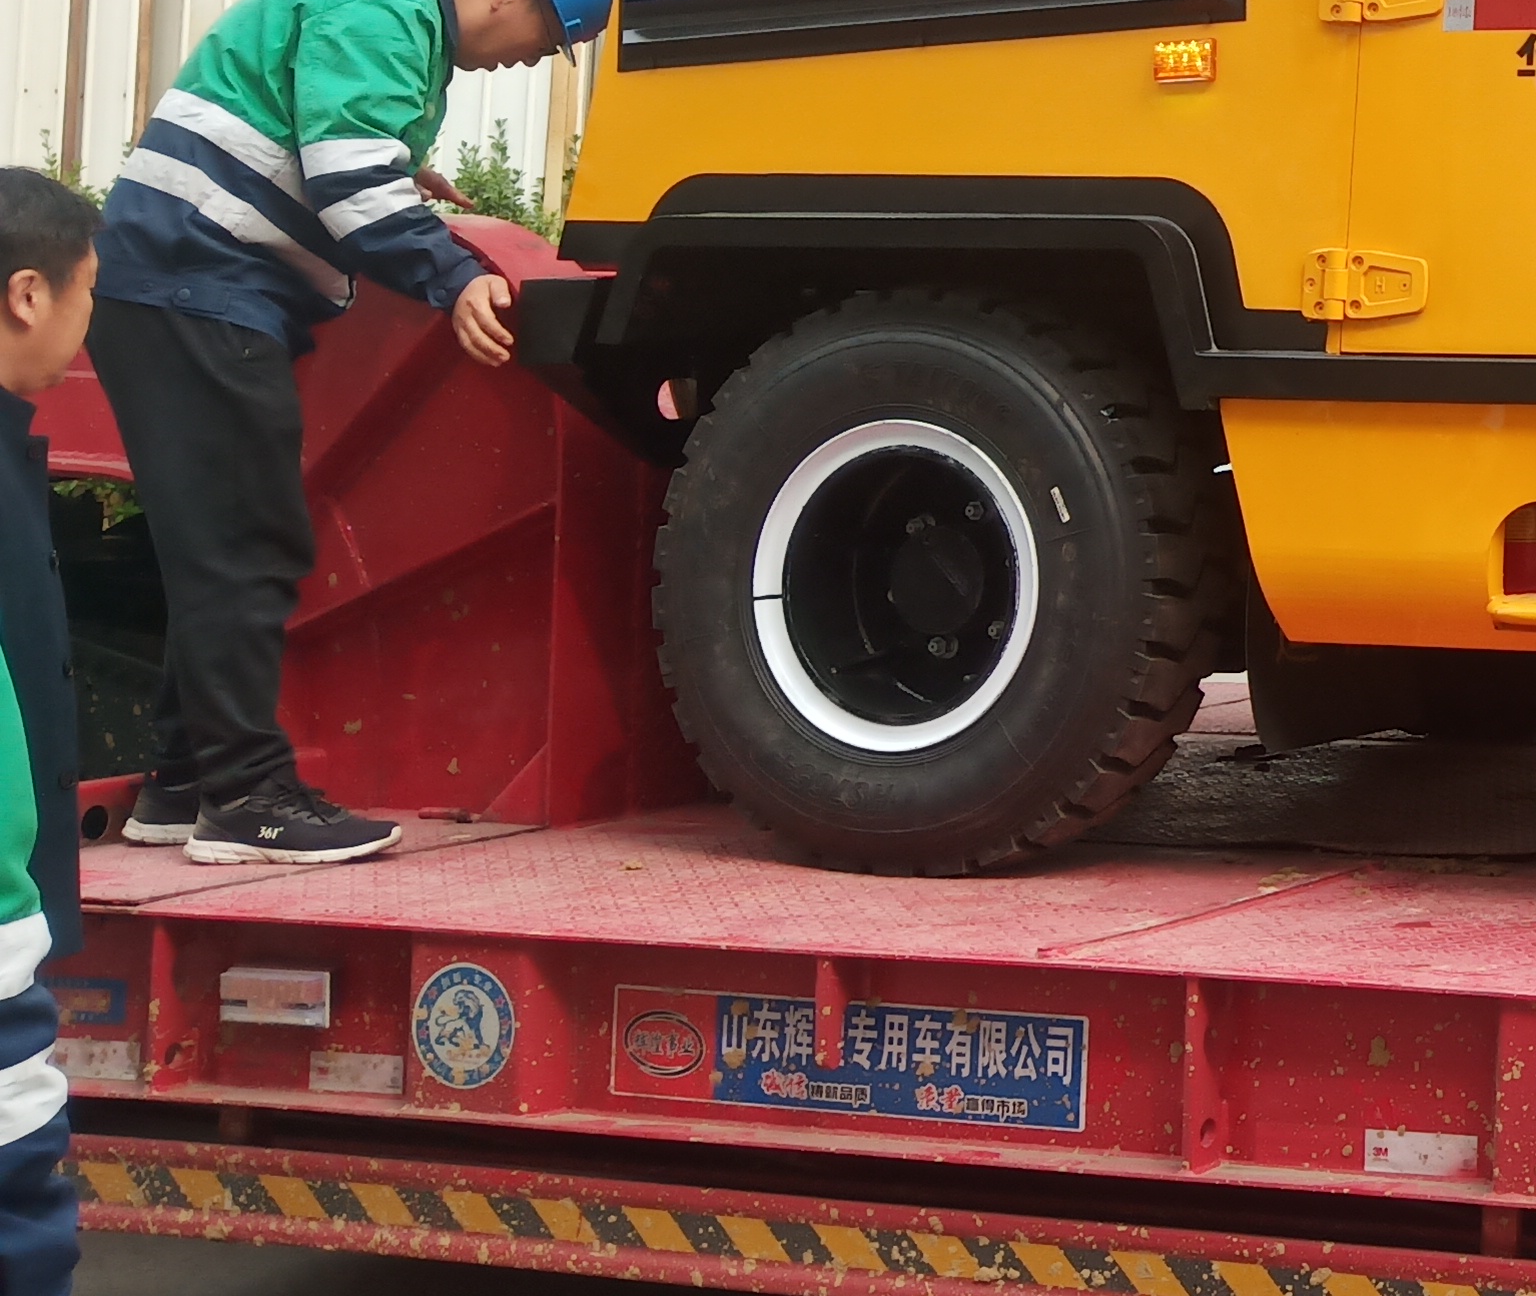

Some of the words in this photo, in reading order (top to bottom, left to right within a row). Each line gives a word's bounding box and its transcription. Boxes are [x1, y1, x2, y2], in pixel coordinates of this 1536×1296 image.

[721, 1002, 1074, 1087] 山东辉专用车有限公司
[1372, 1146, 1389, 1157] 3M
